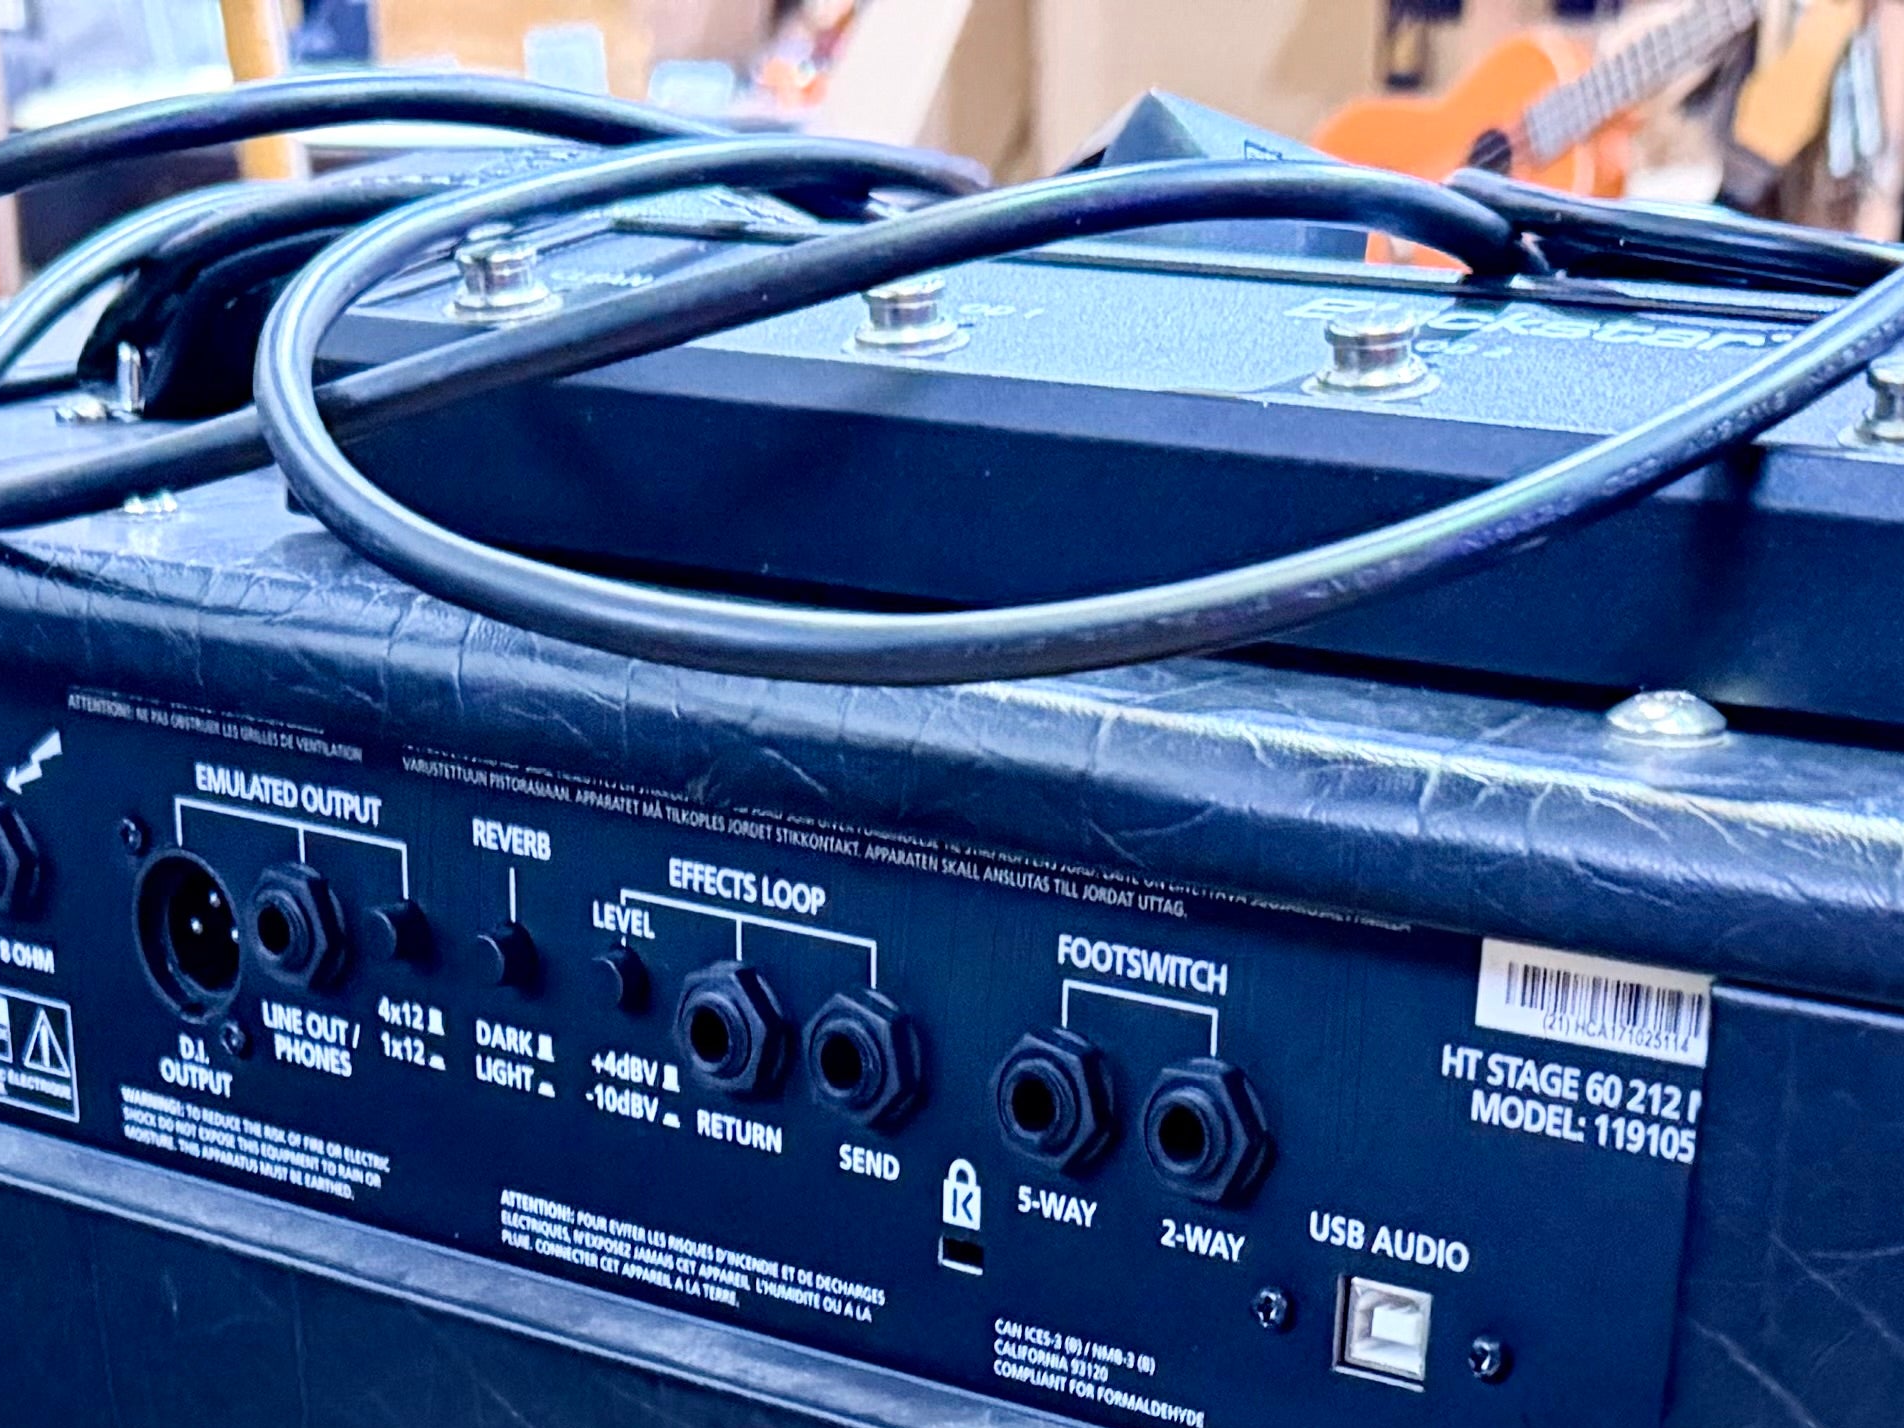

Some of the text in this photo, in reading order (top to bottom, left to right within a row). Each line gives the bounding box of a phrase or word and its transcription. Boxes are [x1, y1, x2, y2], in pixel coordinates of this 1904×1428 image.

[1284, 298, 1765, 351] Bckstar
[151, 708, 169, 727] PAS
[296, 736, 363, 762] VENTILATION
[195, 761, 382, 828] EMULATED OUTPUT
[472, 816, 551, 861] REVERB
[665, 805, 725, 833] TILKOPLES
[727, 814, 772, 842] JORDET
[864, 842, 938, 873] APPARATEN
[941, 855, 981, 882] SKALL
[983, 866, 1051, 894] ANSLUTAS
[1052, 878, 1079, 901] TILL
[1081, 884, 1135, 909] JORDAT
[668, 856, 826, 916] EFFECTS LOOP
[592, 900, 655, 940] LEVEL
[12, 942, 55, 974] OHM
[1057, 933, 1229, 997] FOOTSWITCH
[261, 998, 360, 1049] LINE OUT /
[378, 994, 424, 1031] 4x12
[1542, 1014, 1689, 1052] (21) HCA171025114
[179, 1032, 210, 1064] D.I.
[273, 1032, 352, 1077] PHONES
[380, 1030, 425, 1066] 1x12
[475, 1018, 533, 1058] DARK
[159, 1056, 233, 1098] OUTPUT
[475, 1053, 534, 1092] LIGHT
[591, 1049, 658, 1087] +4dBV
[1441, 1043, 1483, 1080] HT
[1486, 1053, 1581, 1102] STAGE
[1586, 1071, 1623, 1109] 60
[1626, 1079, 1682, 1121] 212
[585, 1084, 659, 1124] -10dBV
[1470, 1089, 1586, 1143] MODEL:
[158, 1115, 174, 1132] DO
[176, 1120, 197, 1139] NOT
[321, 1157, 336, 1175] TO
[365, 1170, 381, 1189] OR
[186, 1103, 201, 1120] TO
[202, 1108, 241, 1133] REDUCE
[327, 1141, 342, 1158] OR
[344, 1146, 391, 1173] ELECTRIC
[696, 1108, 783, 1155] RETURN
[259, 1160, 288, 1181] MUST
[838, 1142, 900, 1182] SEND
[1017, 1184, 1098, 1230] 5-WAY
[577, 1210, 607, 1233] POUR
[609, 1218, 646, 1242] EVITER
[648, 1229, 666, 1247] LES
[667, 1234, 714, 1262] RISQUES
[781, 1262, 795, 1281] ET
[797, 1267, 814, 1288] DE
[815, 1273, 885, 1306] DECHARGES
[1160, 1218, 1246, 1264] 2-WAY
[1309, 1209, 1470, 1273] USB AUDIO
[535, 1239, 598, 1270] CONNECTER
[600, 1256, 620, 1275] CET
[685, 1280, 701, 1297] LA
[633, 1245, 674, 1271] JAMAIS
[676, 1255, 697, 1276] CET
[823, 1293, 842, 1314] OU
[856, 1301, 872, 1323] LA
[995, 1318, 1022, 1339] CAN
[1025, 1325, 1062, 1350] ICES-3
[994, 1338, 1109, 1383] CALIFORNIA 93120
[994, 1359, 1067, 1392] COMPLIANT
[1069, 1378, 1095, 1400] FOR
